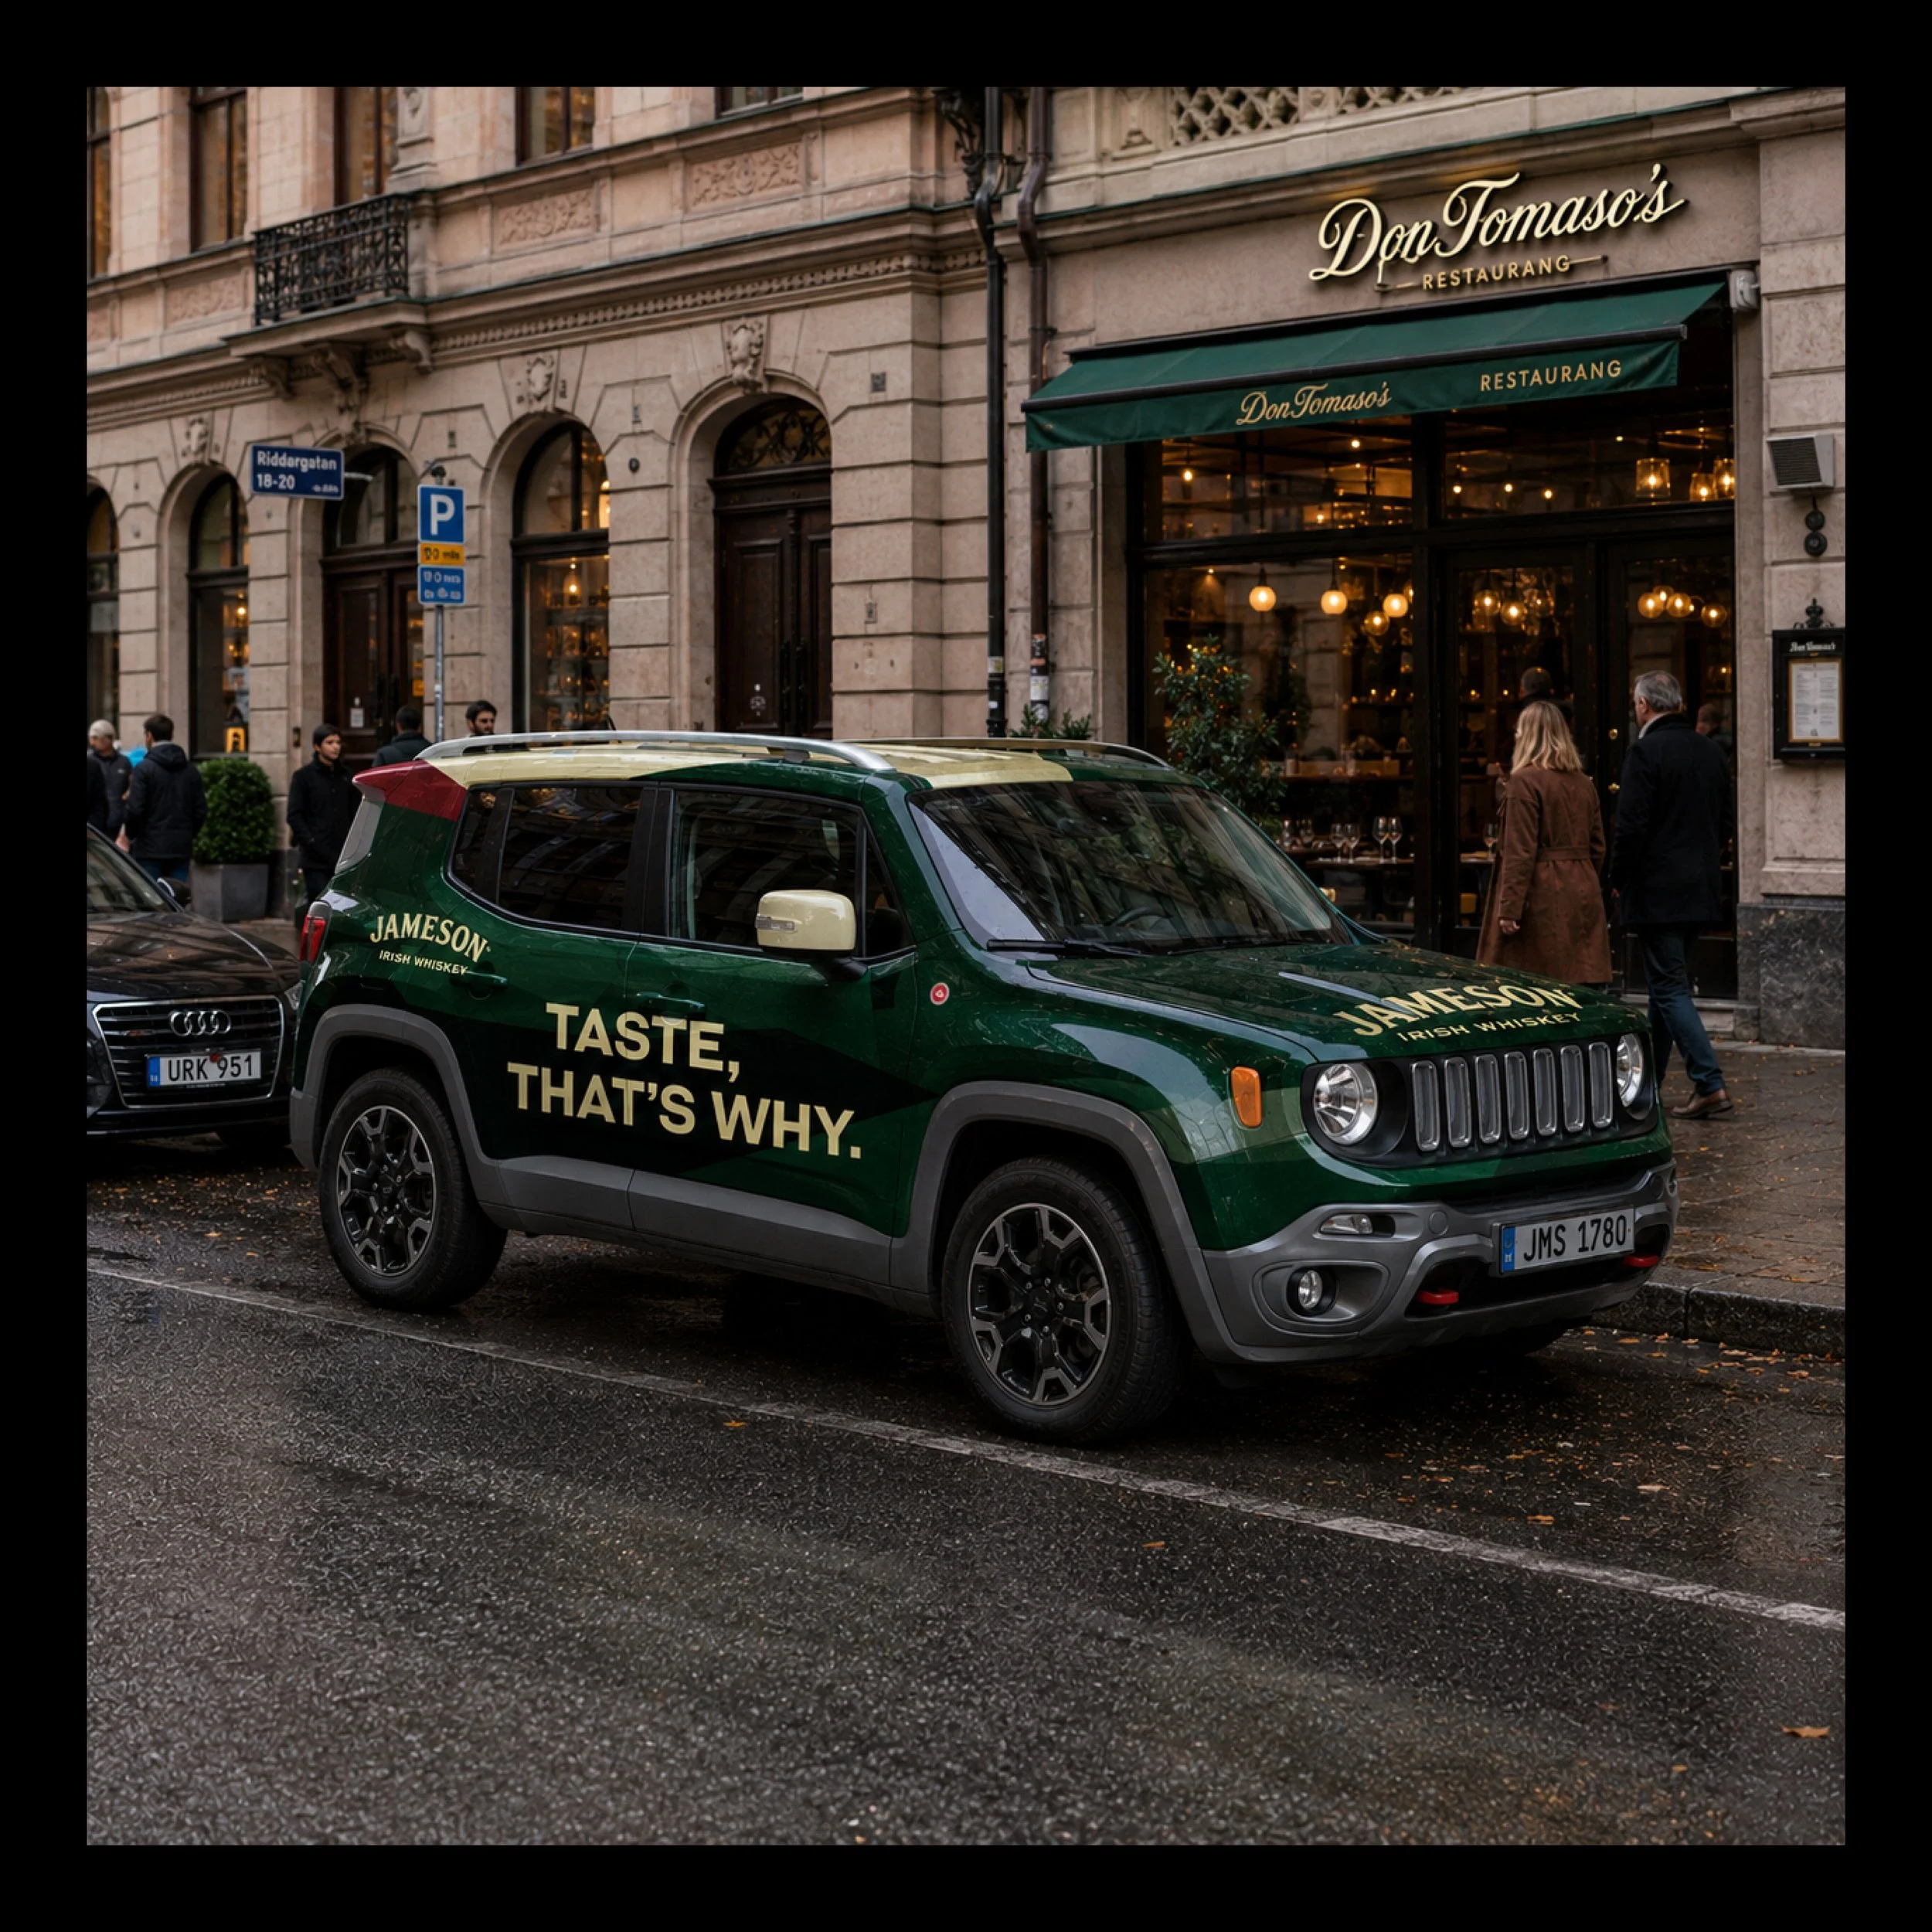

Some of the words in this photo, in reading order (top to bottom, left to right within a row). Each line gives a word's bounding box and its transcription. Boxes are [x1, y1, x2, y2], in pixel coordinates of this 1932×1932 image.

[1308, 198, 1437, 283] Don
[1434, 162, 1688, 257] Tomaso's
[1422, 254, 1570, 291] RESTAURANG
[1480, 359, 1623, 393] RESTAURANG
[1236, 390, 1291, 426] Don
[1288, 380, 1393, 419] Tomaso's
[257, 473, 296, 490] 18-20
[430, 494, 455, 536] P
[369, 913, 488, 963] JAMESON
[379, 950, 412, 964] IRISH
[414, 955, 469, 975] WHISKEY
[1333, 985, 1583, 1036] JAMESON
[1396, 1024, 1471, 1042] IRISH
[1473, 1012, 1581, 1032] WHISKEY
[545, 1002, 740, 1083] TASTE,
[168, 1057, 209, 1082] URK
[216, 1054, 253, 1079] 951
[506, 1062, 696, 1134] THAT'S
[711, 1090, 862, 1159] WHY.
[1523, 1223, 1566, 1261] JMS
[1577, 1215, 1628, 1253] 1780
